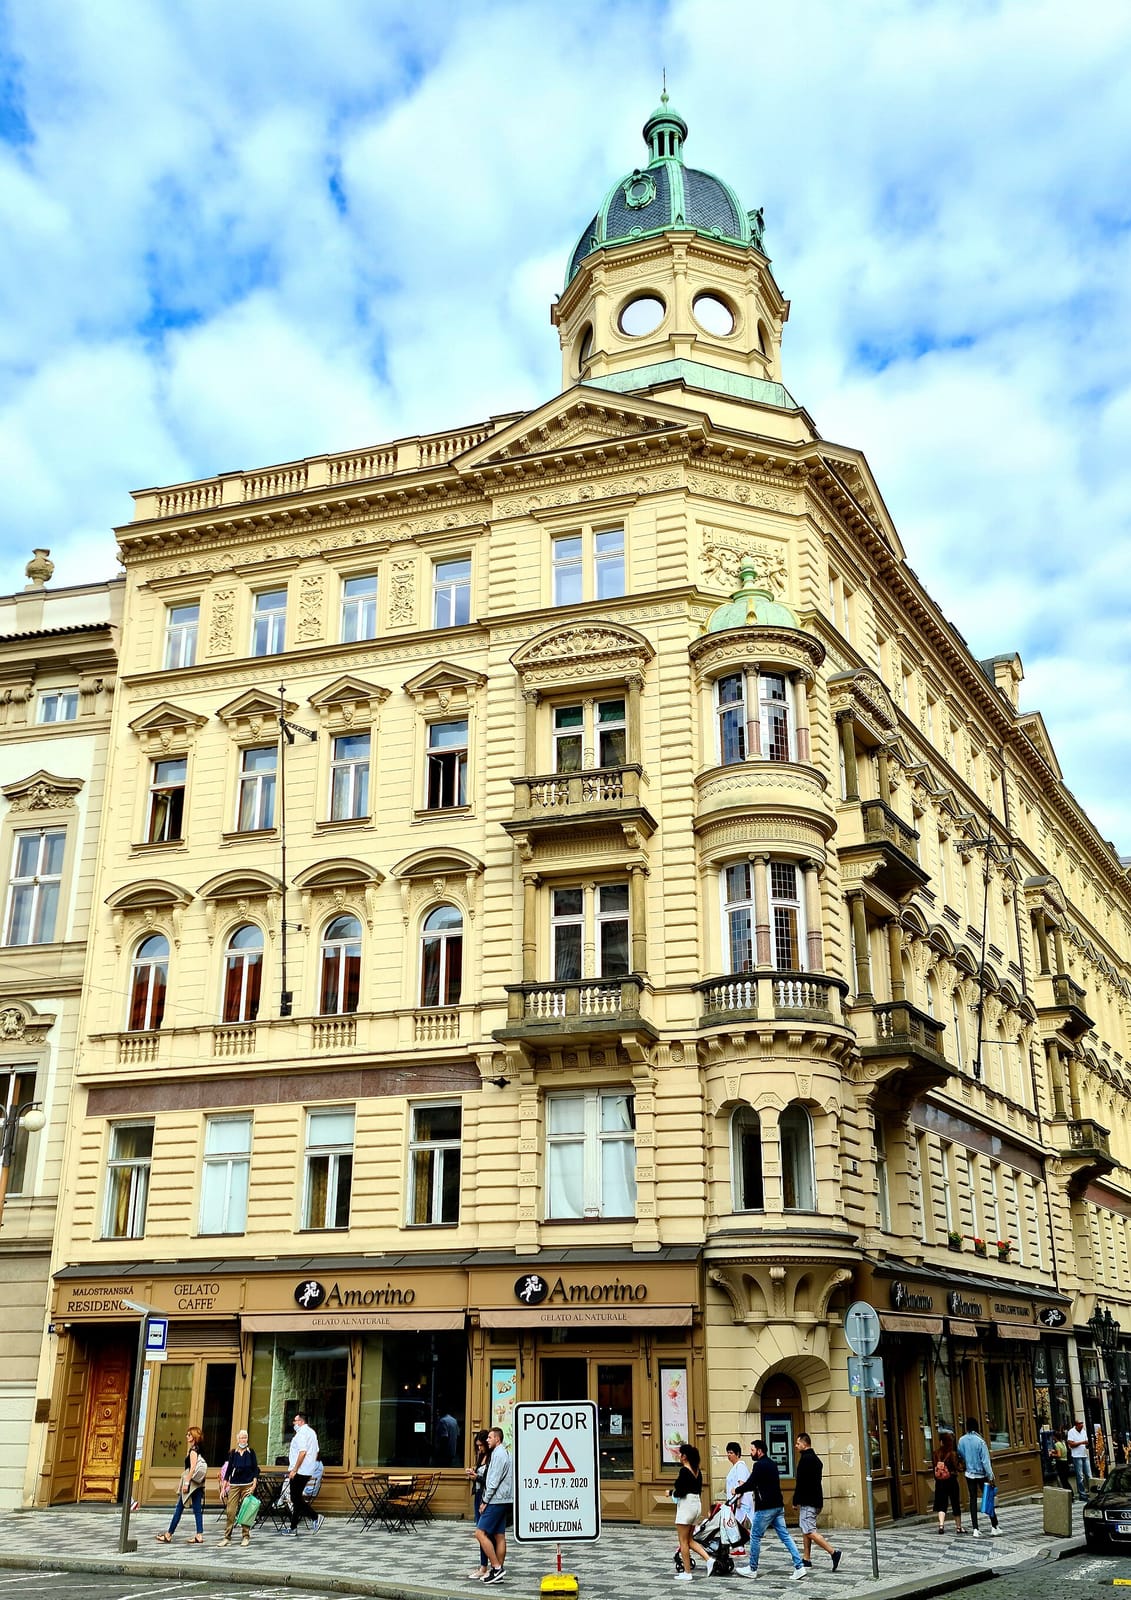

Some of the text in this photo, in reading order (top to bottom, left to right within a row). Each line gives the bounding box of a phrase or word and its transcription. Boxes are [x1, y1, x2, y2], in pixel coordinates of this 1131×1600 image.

[72, 1285, 134, 1297] MALOSTRANSKÁ
[174, 1283, 220, 1296] GELATO
[324, 1281, 416, 1307] Amorino
[548, 1276, 647, 1303] Amorino
[584, 1313, 627, 1321] NATURALE
[523, 1412, 588, 1431] POZOR
[523, 1478, 541, 1489] 13.9.
[550, 1478, 568, 1488] 17.9.
[570, 1477, 588, 1488] 2020
[529, 1497, 580, 1511] ul. LETENSKÁ
[528, 1518, 583, 1533] NEPRŮJEZDNÁ
